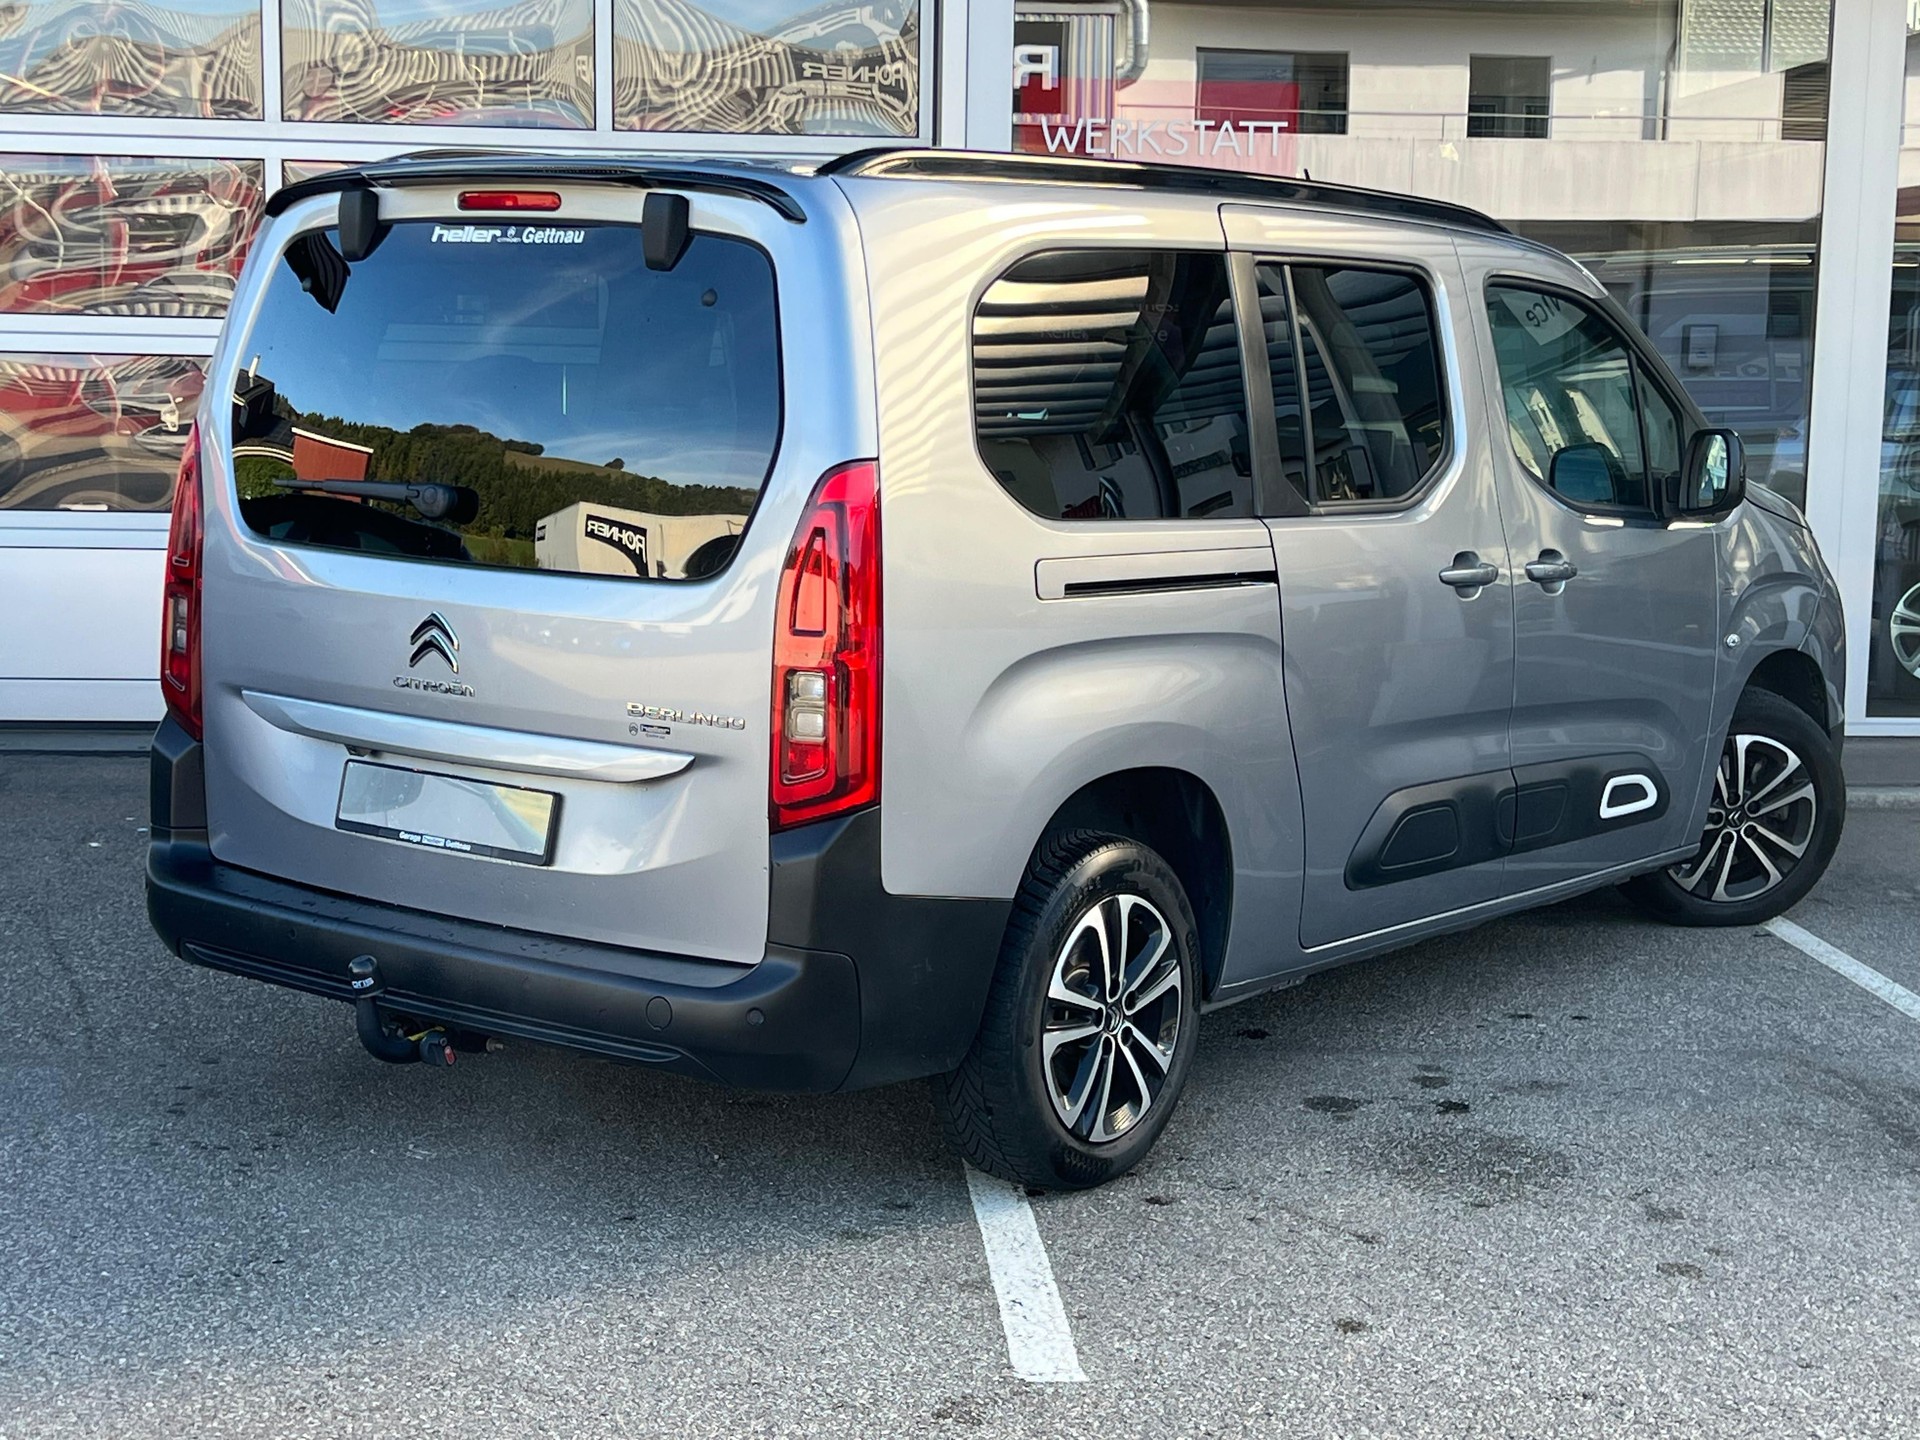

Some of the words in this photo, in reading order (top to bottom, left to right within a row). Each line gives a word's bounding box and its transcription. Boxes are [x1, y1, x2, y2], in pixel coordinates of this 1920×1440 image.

[1041, 115, 1289, 157] WERKSTATT
[431, 226, 501, 243] heller
[522, 227, 585, 244] Gettnau
